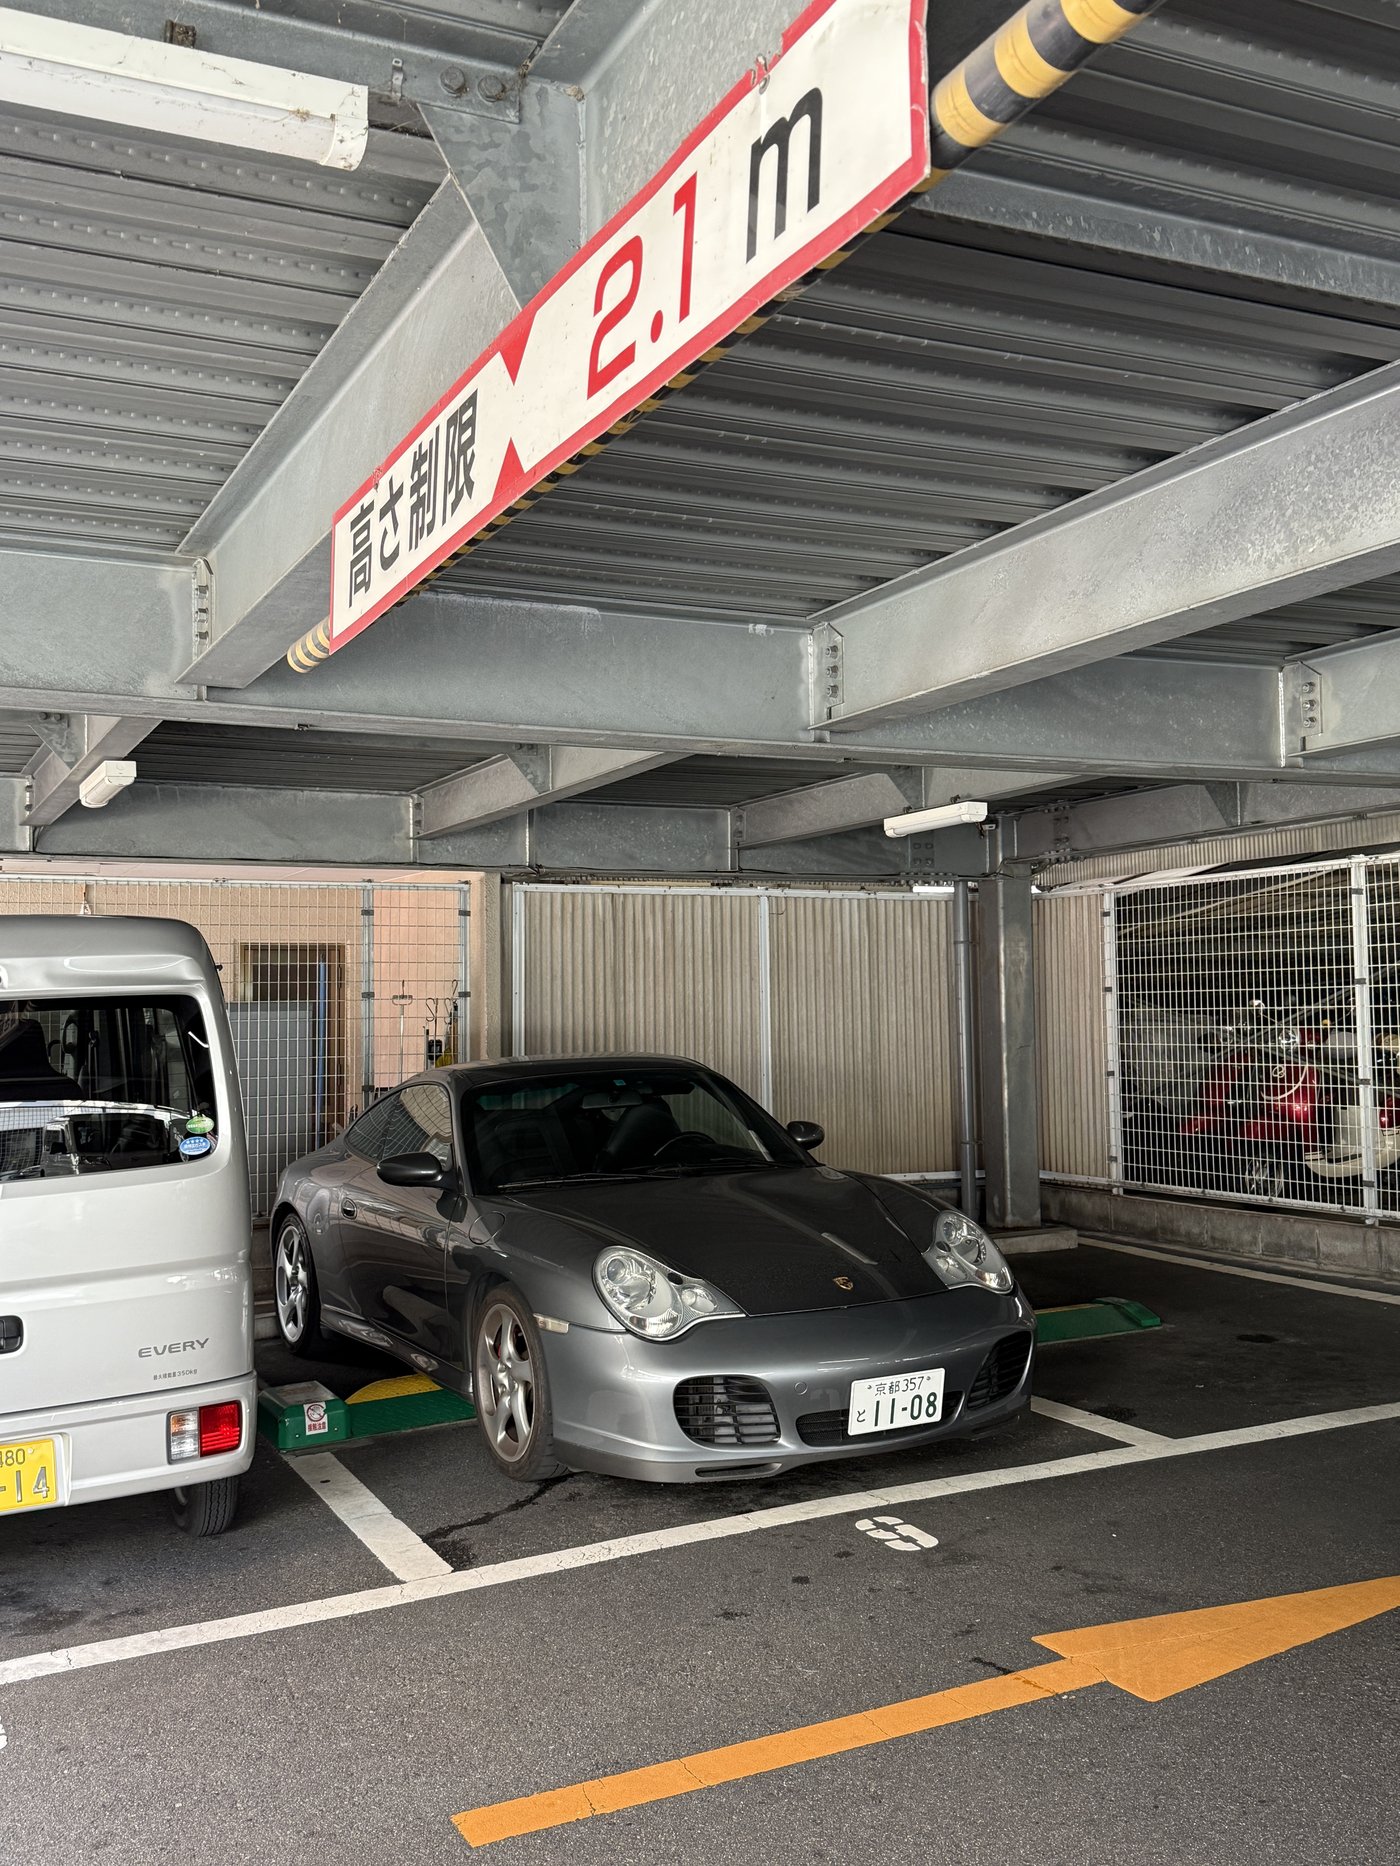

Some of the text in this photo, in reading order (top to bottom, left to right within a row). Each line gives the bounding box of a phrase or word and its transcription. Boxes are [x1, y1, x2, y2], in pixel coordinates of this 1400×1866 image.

[348, 87, 824, 609] 高さ制限 2.1 m
[138, 1338, 209, 1358] EVERY
[856, 1392, 938, 1427] と 11-08
[0, 1448, 25, 1468] 80
